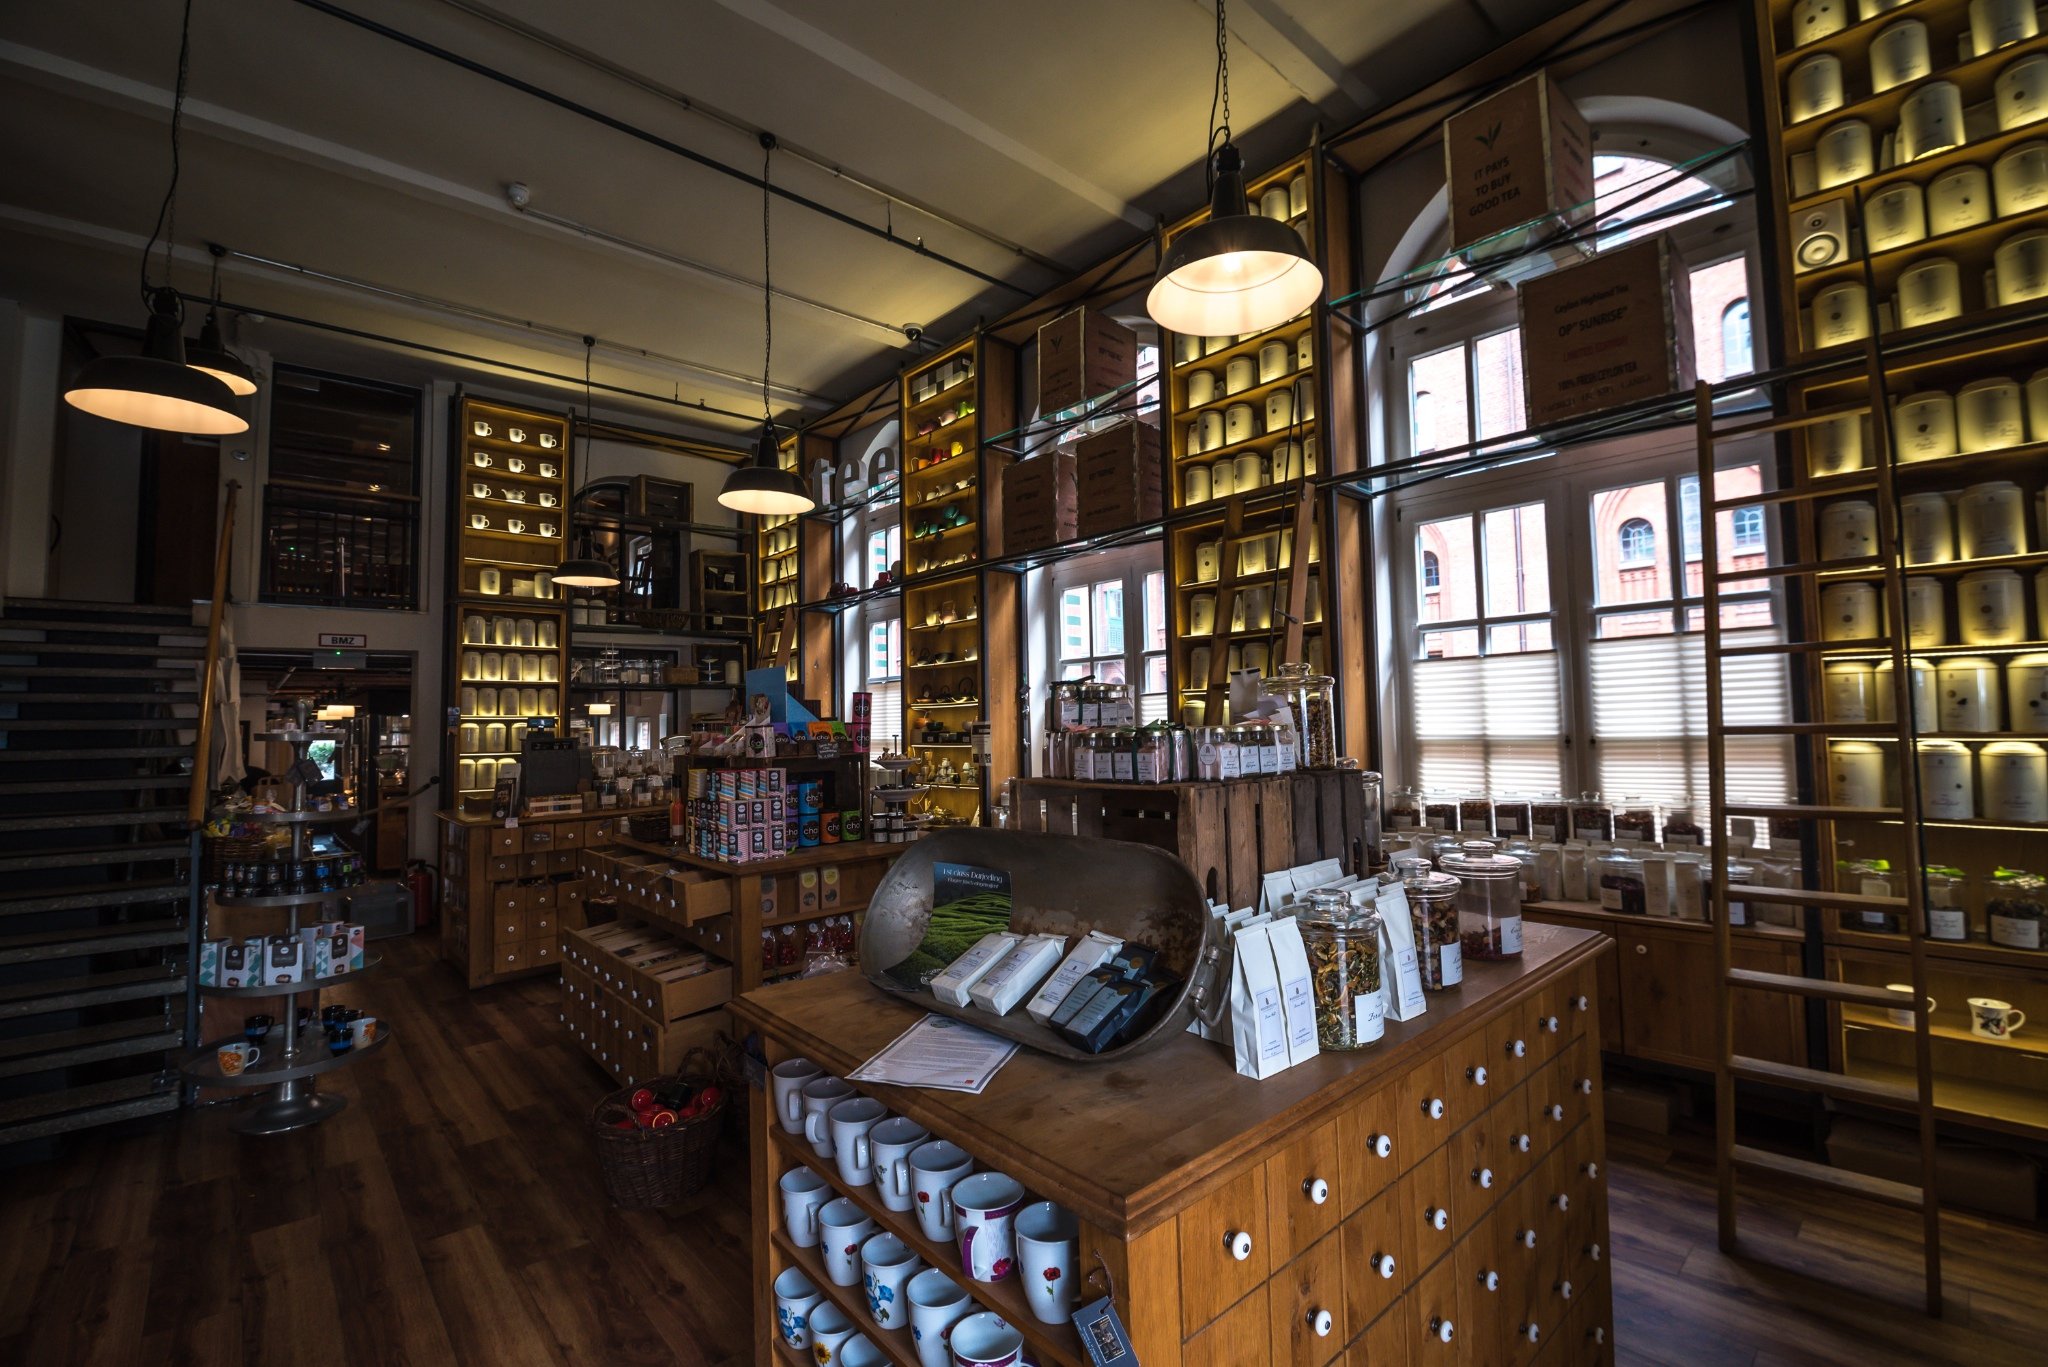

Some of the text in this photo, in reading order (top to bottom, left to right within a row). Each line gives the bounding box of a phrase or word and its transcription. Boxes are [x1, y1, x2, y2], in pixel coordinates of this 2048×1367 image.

[1474, 156, 1509, 180] IT PAYS
[1475, 172, 1511, 197] TO BUY
[1470, 187, 1520, 216] GOOD TEA
[809, 447, 896, 512] tee
[331, 636, 355, 645] BMZ
[953, 868, 970, 878] class
[970, 871, 1003, 884] Darjeeling
